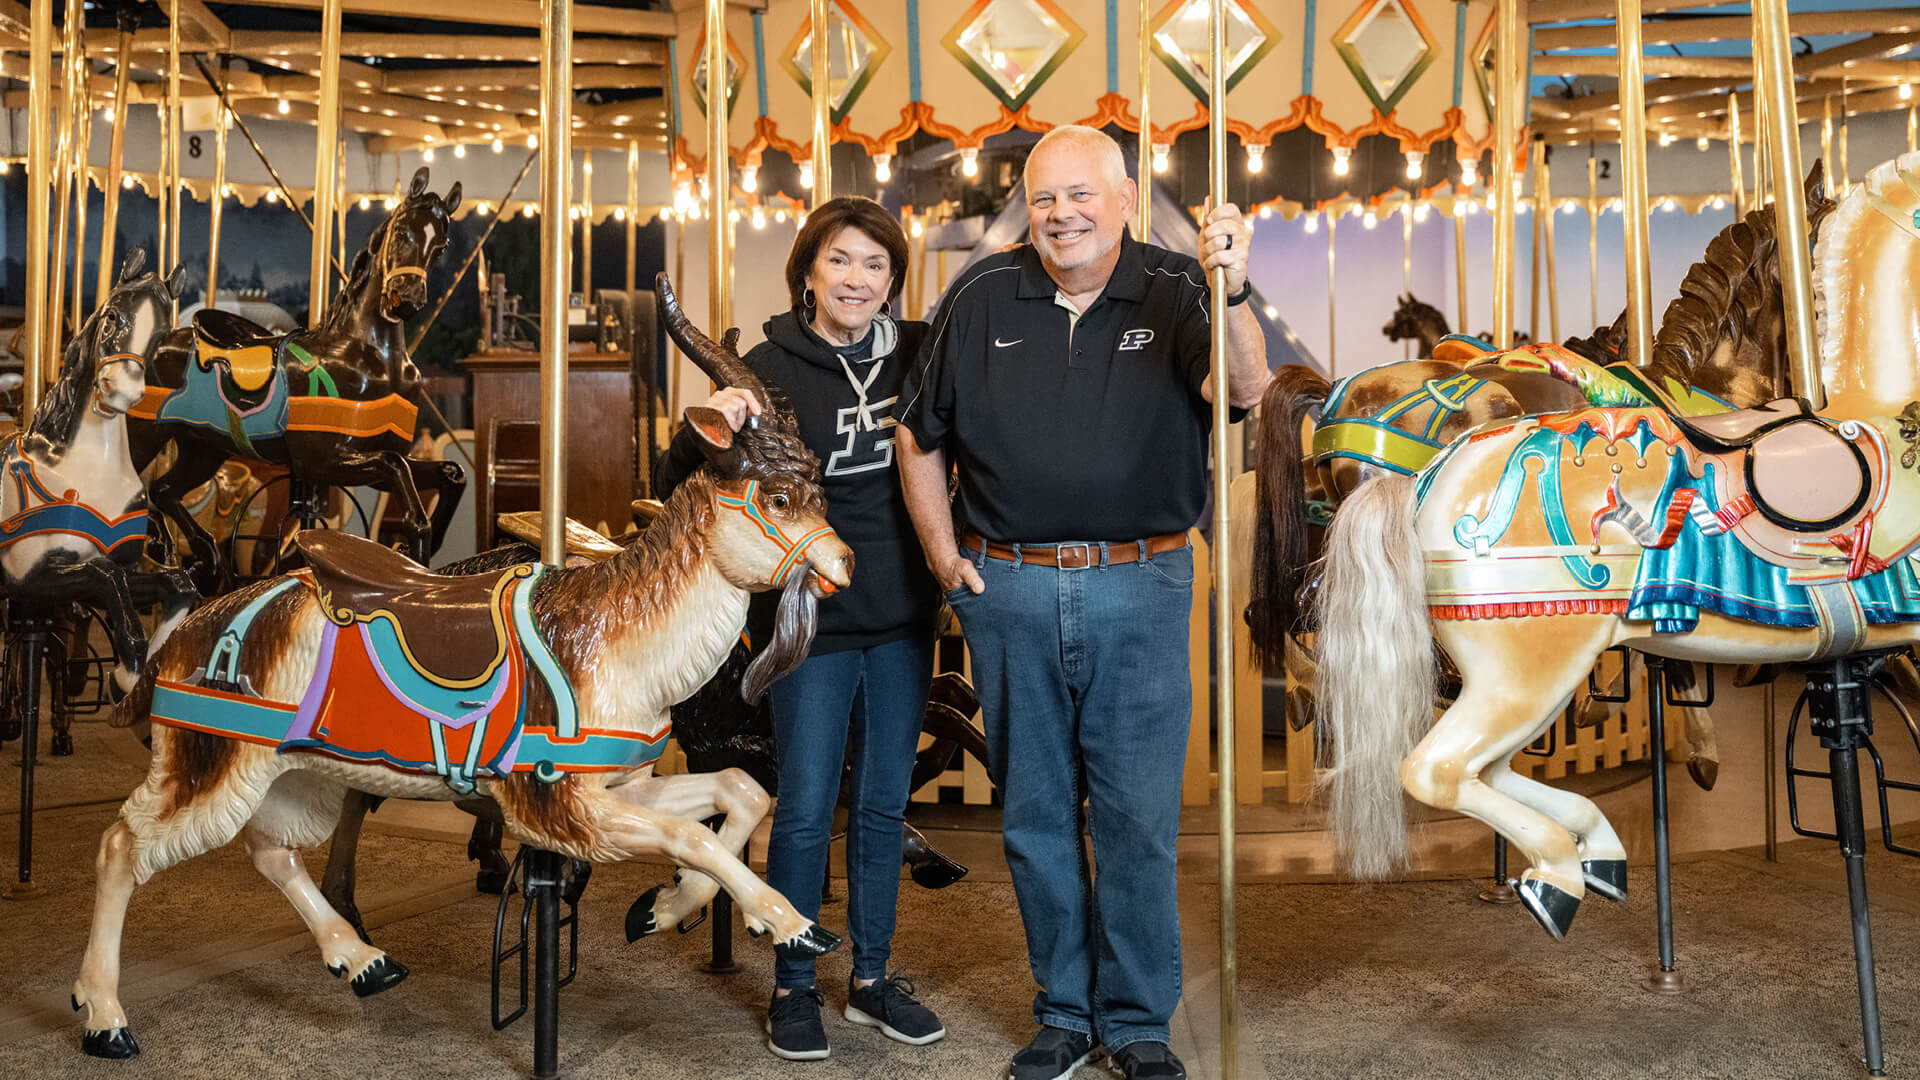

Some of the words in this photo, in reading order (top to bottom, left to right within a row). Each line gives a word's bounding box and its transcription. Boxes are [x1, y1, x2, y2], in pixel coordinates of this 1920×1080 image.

[189, 135, 201, 158] 8
[1600, 160, 1610, 179] 2
[1119, 329, 1154, 350] P
